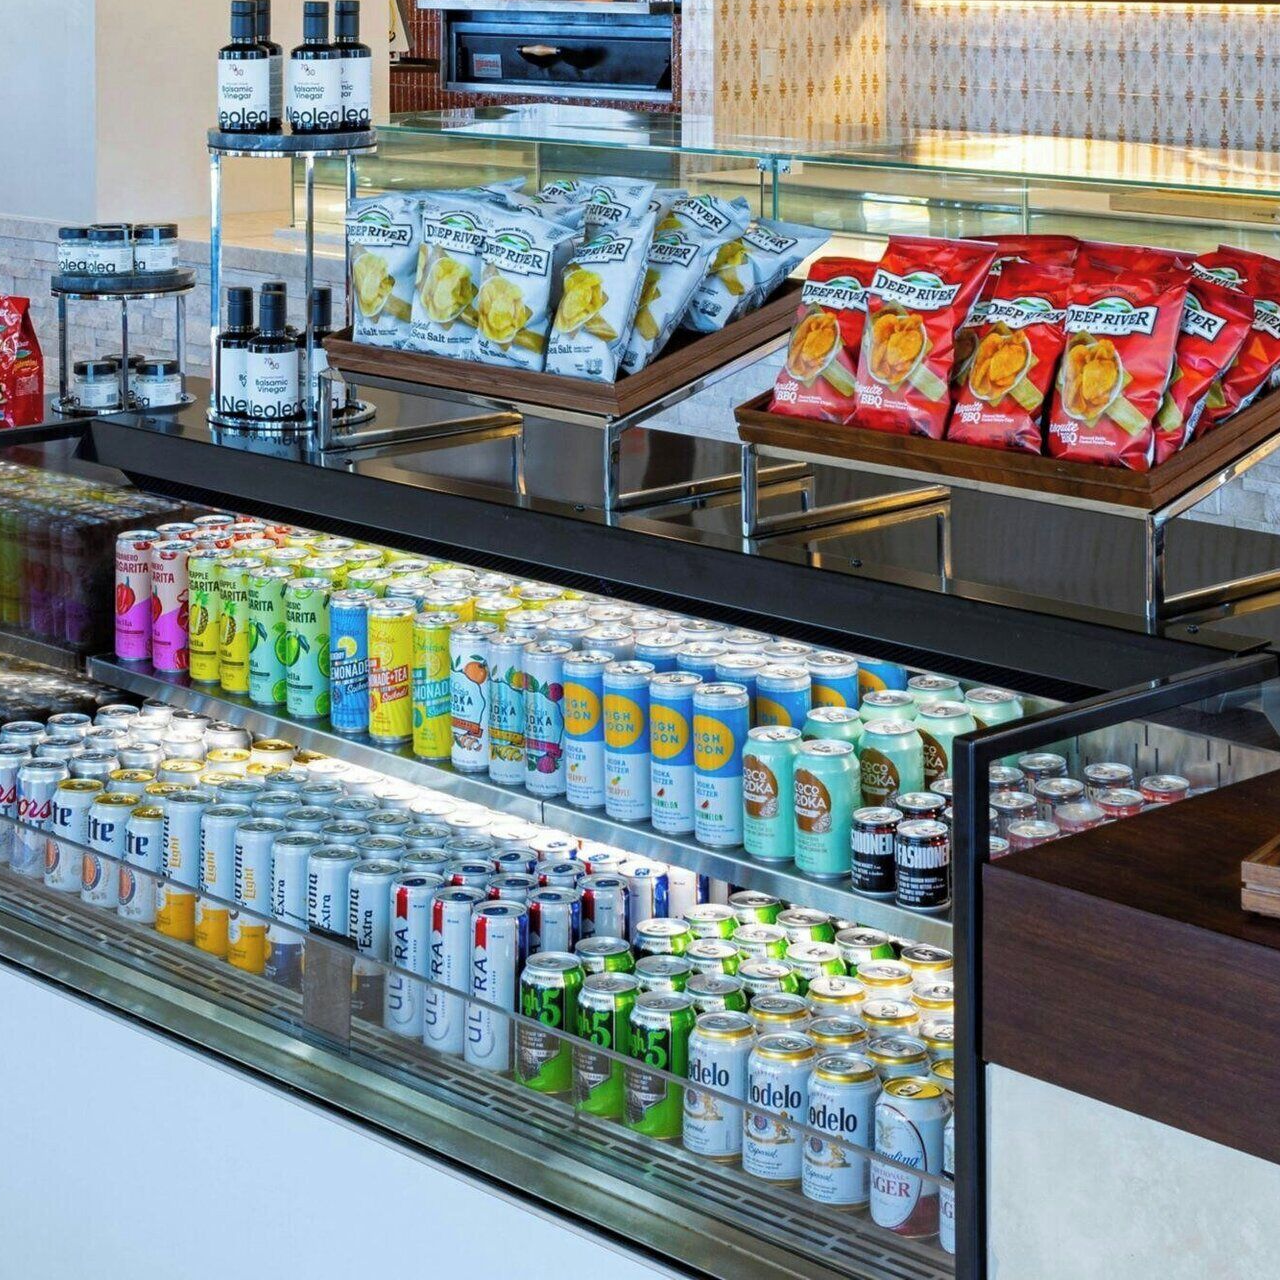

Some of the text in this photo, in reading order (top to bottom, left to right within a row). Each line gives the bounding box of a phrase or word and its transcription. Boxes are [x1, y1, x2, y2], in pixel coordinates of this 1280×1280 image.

[222, 85, 253, 93] Balsamic
[294, 85, 324, 93] Balsamic
[219, 107, 267, 124] eolea
[368, 226, 408, 241] RIVER
[427, 225, 452, 239] DEEP
[592, 243, 625, 256] RIVER
[506, 251, 543, 269] RIVER
[804, 284, 829, 297] DEEP
[875, 274, 956, 300] DEEP RIVER
[988, 303, 1023, 318] DEEP
[1101, 311, 1149, 326] RIVER
[427, 332, 445, 343] Salt
[255, 378, 288, 386] Balsamic
[258, 386, 286, 394] Vinegar
[777, 392, 797, 403] BBQ
[860, 395, 883, 407] BBQ
[962, 411, 981, 423] BBQ
[897, 842, 949, 869] FASHIONE
[275, 879, 285, 917] Extra
[360, 910, 373, 949] Extra
[539, 989, 562, 1027] 5
[590, 1012, 610, 1049] 5
[645, 1030, 667, 1069] 5
